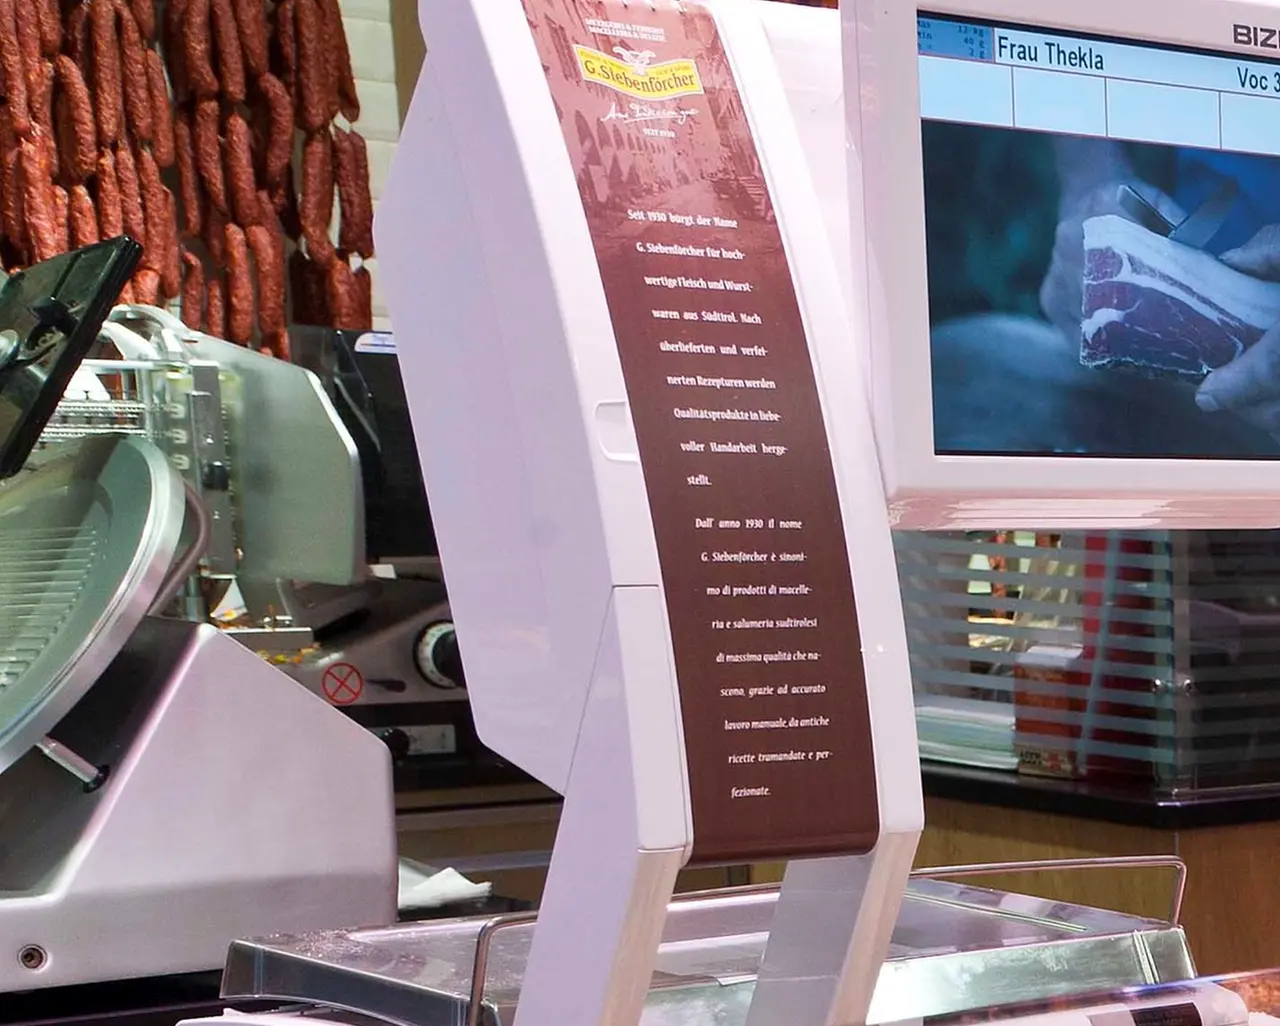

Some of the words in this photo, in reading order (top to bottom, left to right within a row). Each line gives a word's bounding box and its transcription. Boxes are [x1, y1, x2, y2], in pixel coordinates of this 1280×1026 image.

[998, 36, 1038, 62] Frau
[1045, 42, 1104, 70] Thekla
[1237, 66, 1268, 90] Voc
[628, 209, 645, 220] Seit
[647, 211, 666, 222] 1930
[697, 215, 712, 225] der
[714, 217, 738, 228] Name
[636, 242, 646, 252] G.
[706, 247, 720, 258] für
[722, 248, 745, 259] hoch-
[644, 276, 677, 288] wertige
[677, 277, 706, 289] Fleisch
[708, 280, 724, 290] und
[724, 281, 753, 292] Wurst-
[652, 310, 680, 319] waren
[683, 311, 698, 320] aus
[740, 313, 762, 324] Nach
[720, 344, 737, 355] und
[741, 346, 768, 356] verfei-
[667, 376, 696, 386] nerten
[696, 376, 744, 389] Rezepturen
[745, 378, 776, 389] werden
[751, 410, 758, 420] in
[759, 410, 781, 422] liebe-
[680, 441, 705, 451] voller
[710, 442, 757, 453] Handarbeit
[762, 443, 788, 456] herge-
[687, 474, 712, 485] stellt.
[719, 520, 741, 528] anno
[746, 519, 763, 528] 1930
[780, 520, 802, 529] nome
[701, 552, 709, 562] G.
[779, 553, 808, 562] sinoni-
[707, 587, 720, 595] mo
[722, 585, 730, 595] di
[733, 585, 767, 596] prodotti
[768, 585, 777, 594] di
[779, 585, 812, 594] macelle-
[712, 619, 724, 629] ria
[733, 618, 774, 629] salumeria
[716, 653, 724, 662] di
[726, 653, 761, 662] massima
[763, 651, 791, 663] qualità
[793, 651, 806, 661] che
[808, 651, 821, 660] na-
[749, 685, 774, 698] grazie
[777, 684, 788, 694] ad
[791, 684, 826, 694] accurato
[725, 720, 750, 730] lavoro
[751, 718, 788, 729] manuale,
[788, 717, 798, 727] da
[800, 716, 829, 727] antiche
[728, 754, 755, 764] ricette
[758, 751, 806, 762] tramandate
[816, 751, 833, 761] per-
[731, 787, 770, 798] fezionate.
